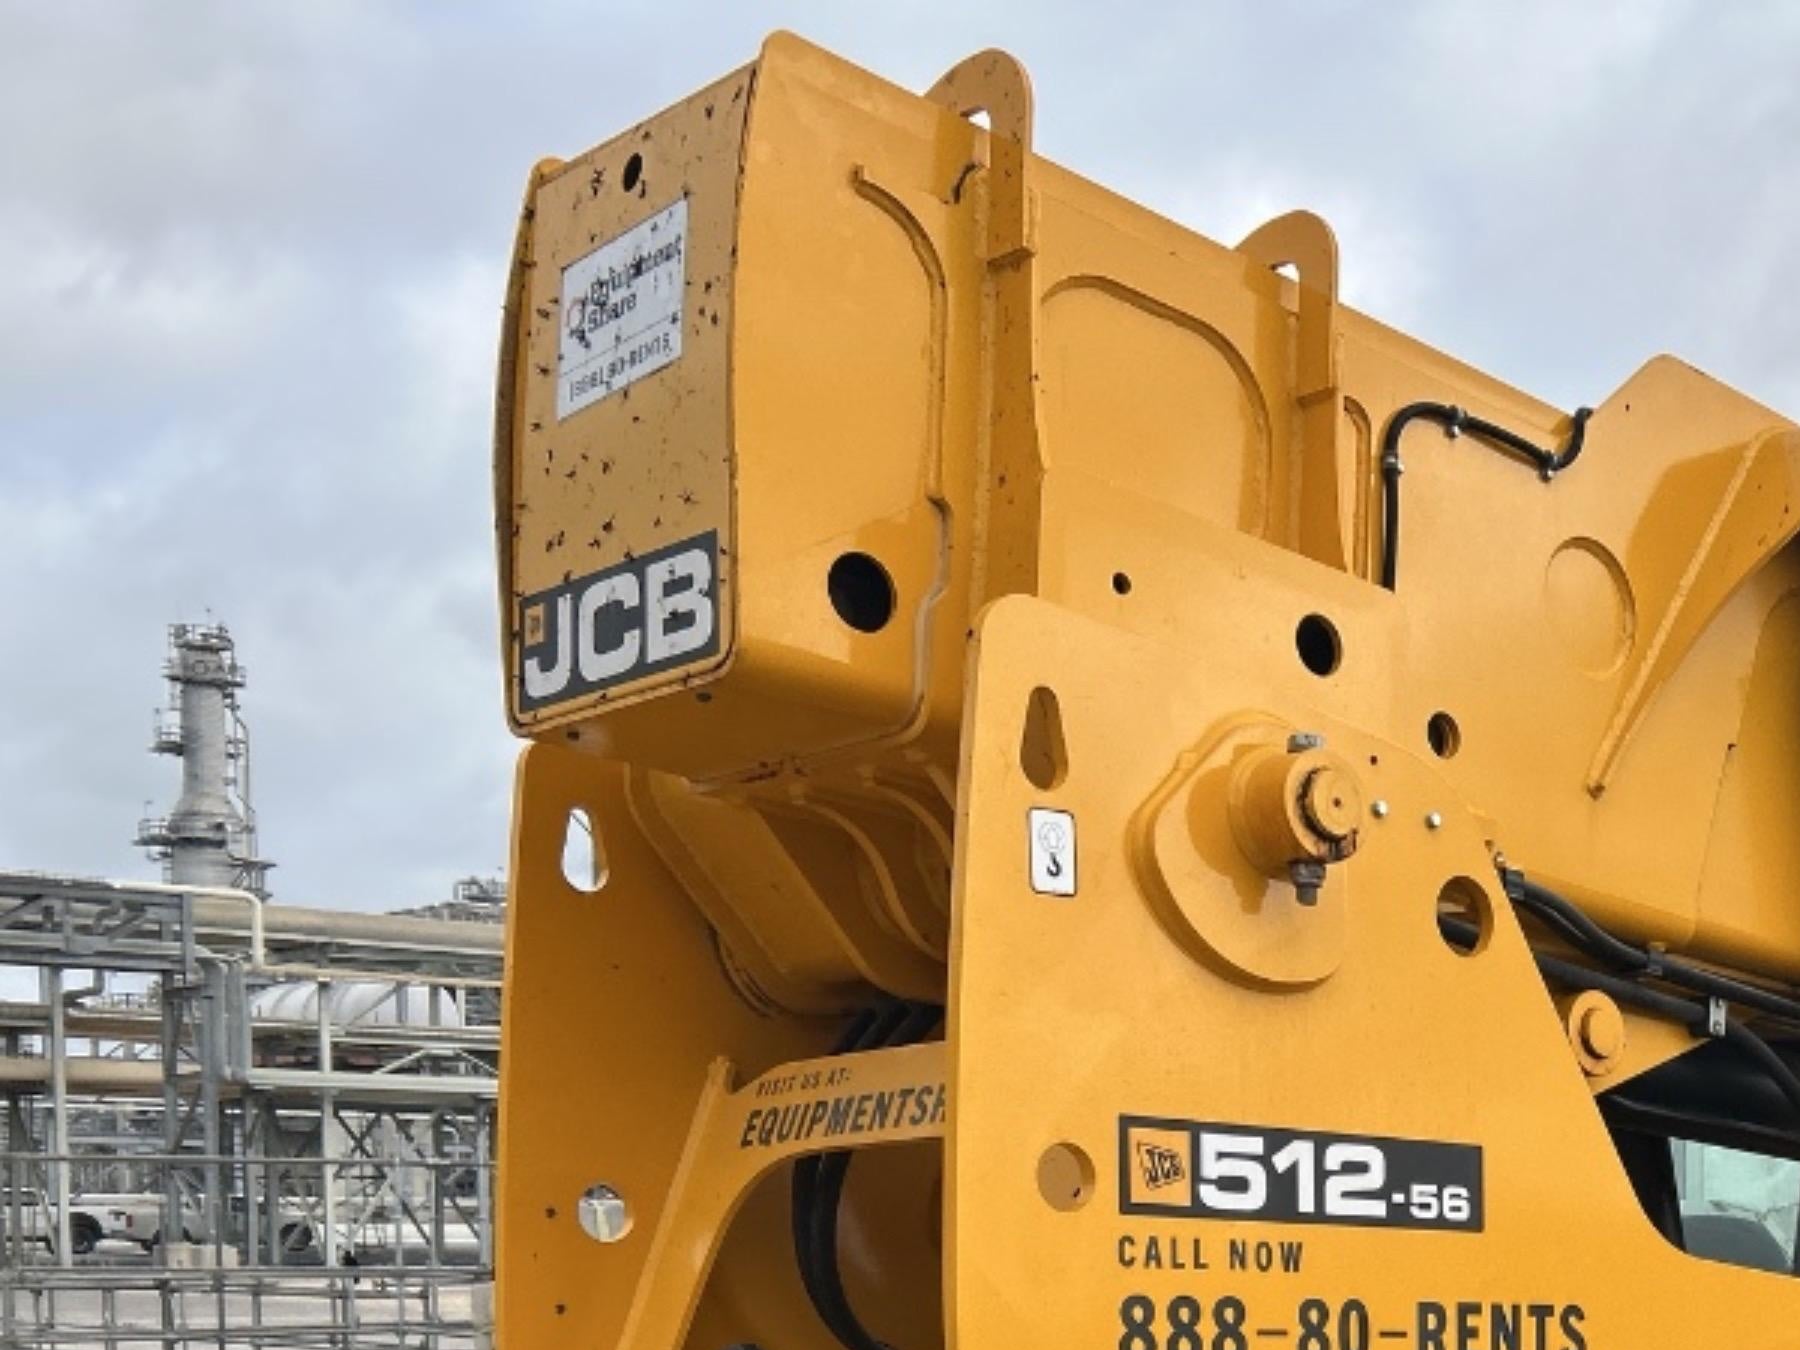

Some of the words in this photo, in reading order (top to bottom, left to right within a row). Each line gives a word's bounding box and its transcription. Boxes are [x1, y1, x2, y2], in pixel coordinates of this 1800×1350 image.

[523, 547, 714, 699] JCB
[1118, 1236, 1210, 1271] CALL
[1229, 1239, 1304, 1273] NOW
